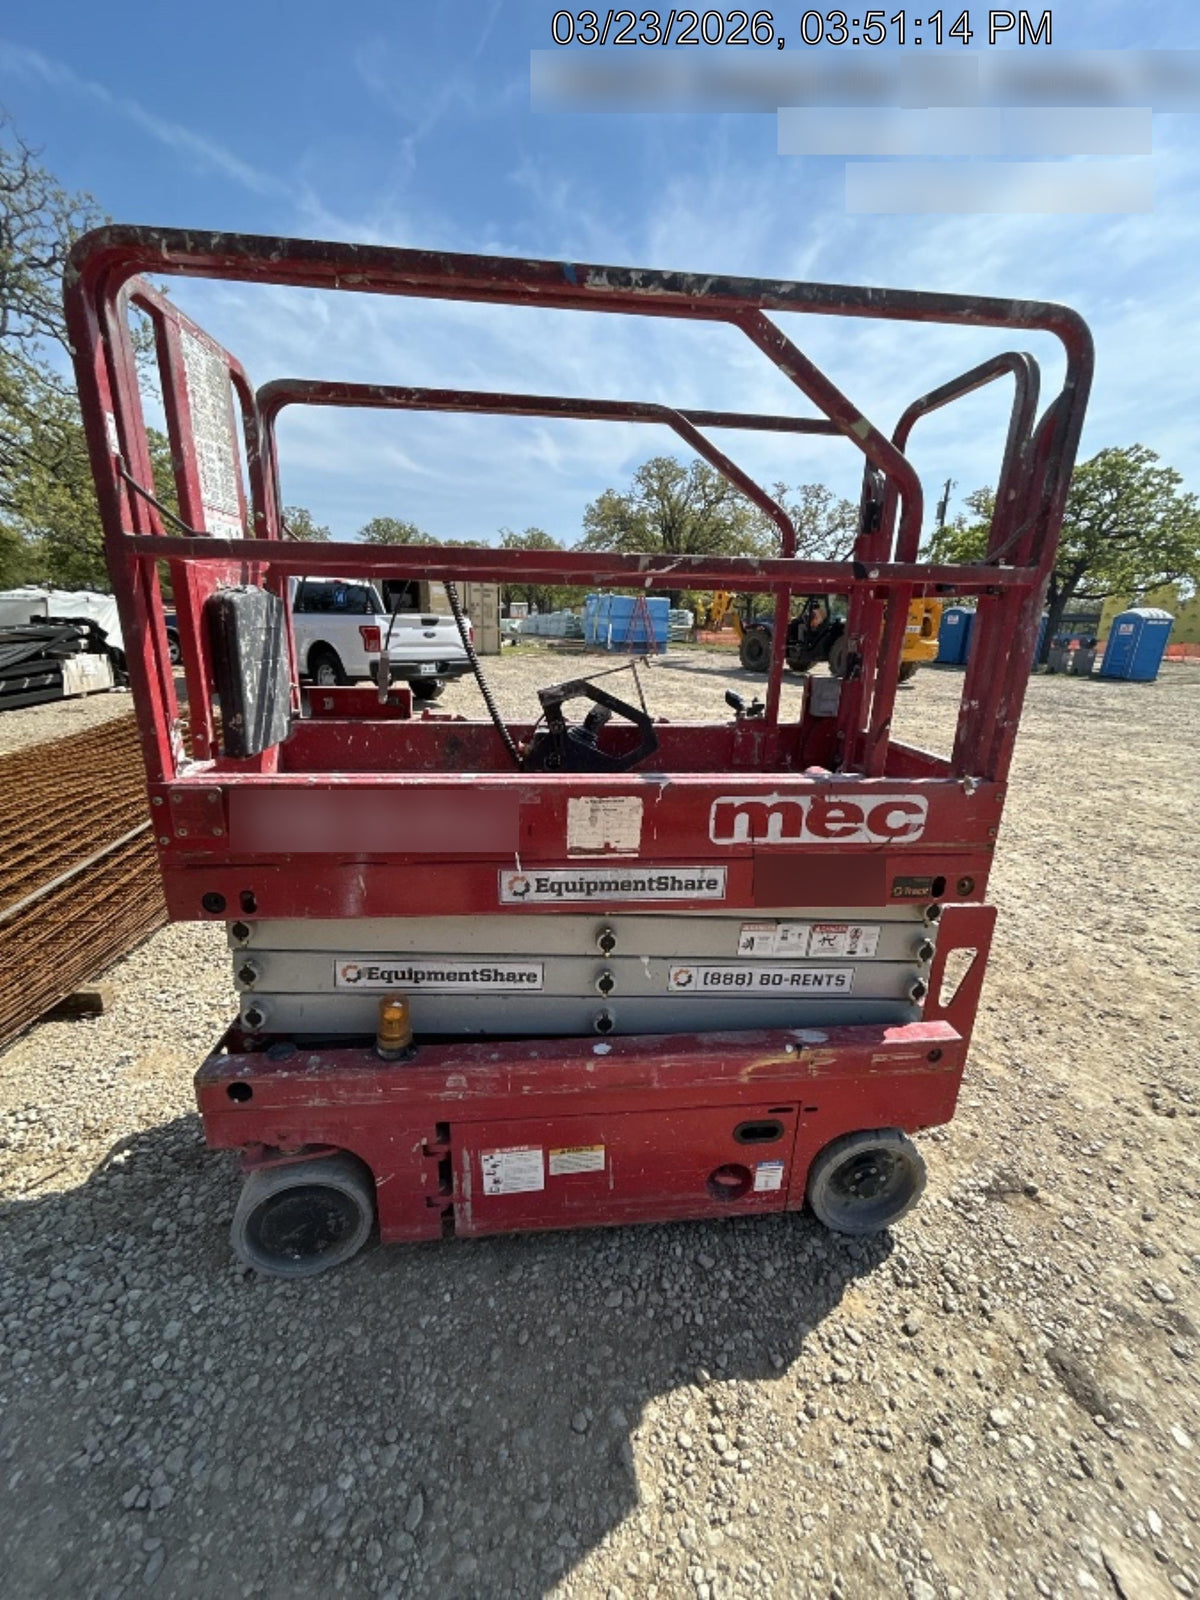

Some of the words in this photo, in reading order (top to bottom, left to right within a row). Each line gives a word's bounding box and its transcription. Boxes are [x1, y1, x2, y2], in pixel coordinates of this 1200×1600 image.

[713, 800, 924, 839] mec
[534, 875, 719, 896] EquipmentShare
[366, 966, 538, 984] EquipmentShare
[702, 971, 753, 987] (888)
[758, 972, 847, 987] 80-RENTS
